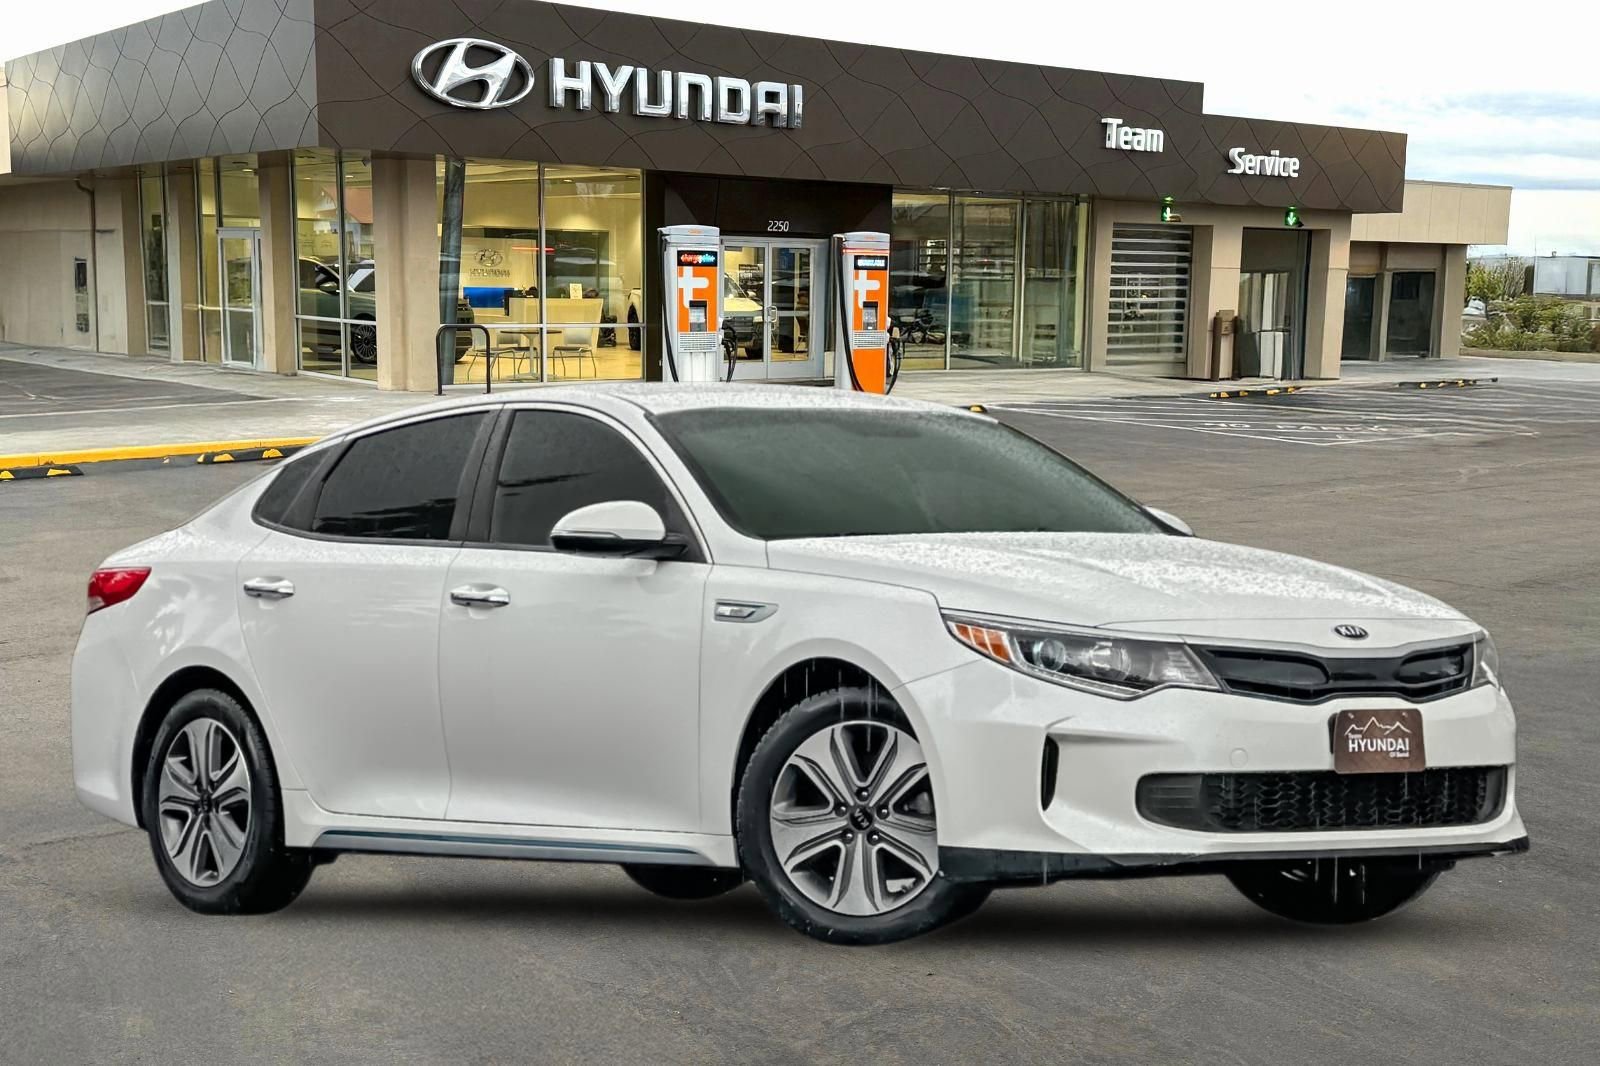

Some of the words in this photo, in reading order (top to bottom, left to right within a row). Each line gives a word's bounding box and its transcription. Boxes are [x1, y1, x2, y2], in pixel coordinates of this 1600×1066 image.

[549, 57, 803, 129] HYUNDAI
[1101, 117, 1164, 152] Team
[1227, 147, 1300, 178] Service
[767, 220, 790, 232] 2250
[1339, 625, 1366, 636] KIA
[1348, 738, 1410, 752] HYUNDAI
